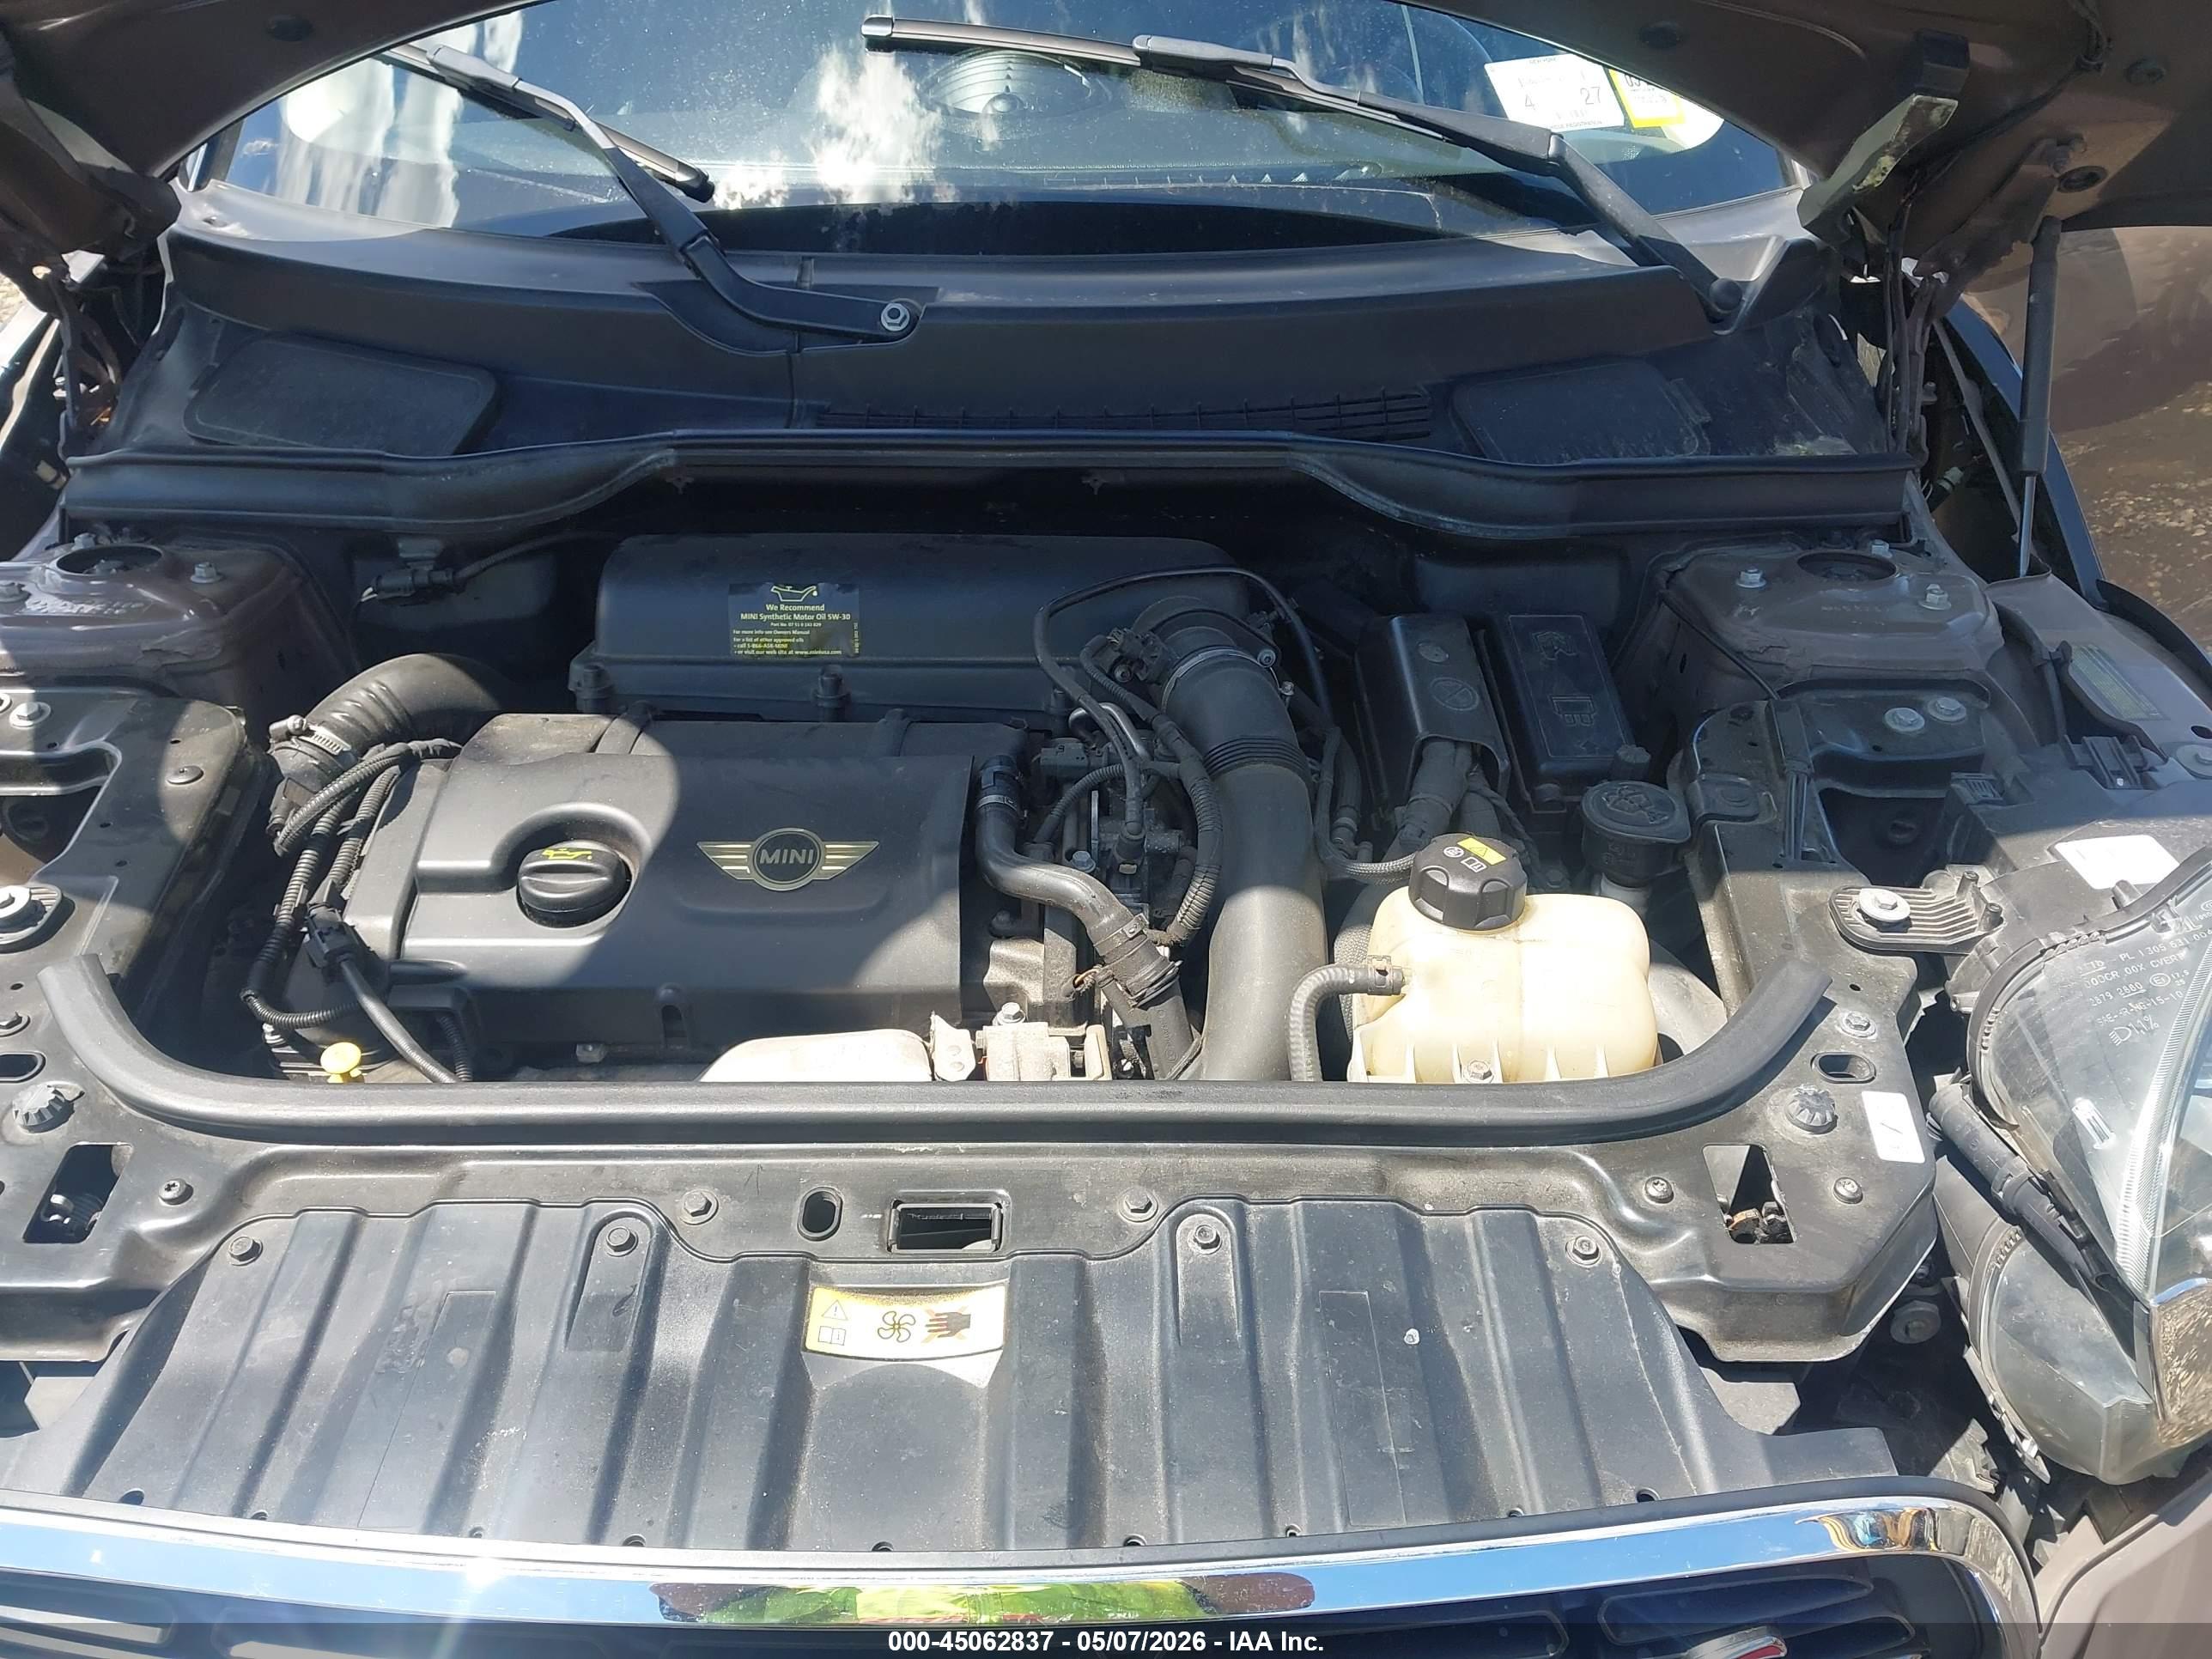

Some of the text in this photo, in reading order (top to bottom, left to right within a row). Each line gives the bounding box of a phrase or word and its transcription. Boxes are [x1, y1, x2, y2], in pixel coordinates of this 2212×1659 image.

[1579, 86, 1601, 106] 27
[759, 612, 792, 622] Synthetic
[760, 849, 815, 864] MINI
